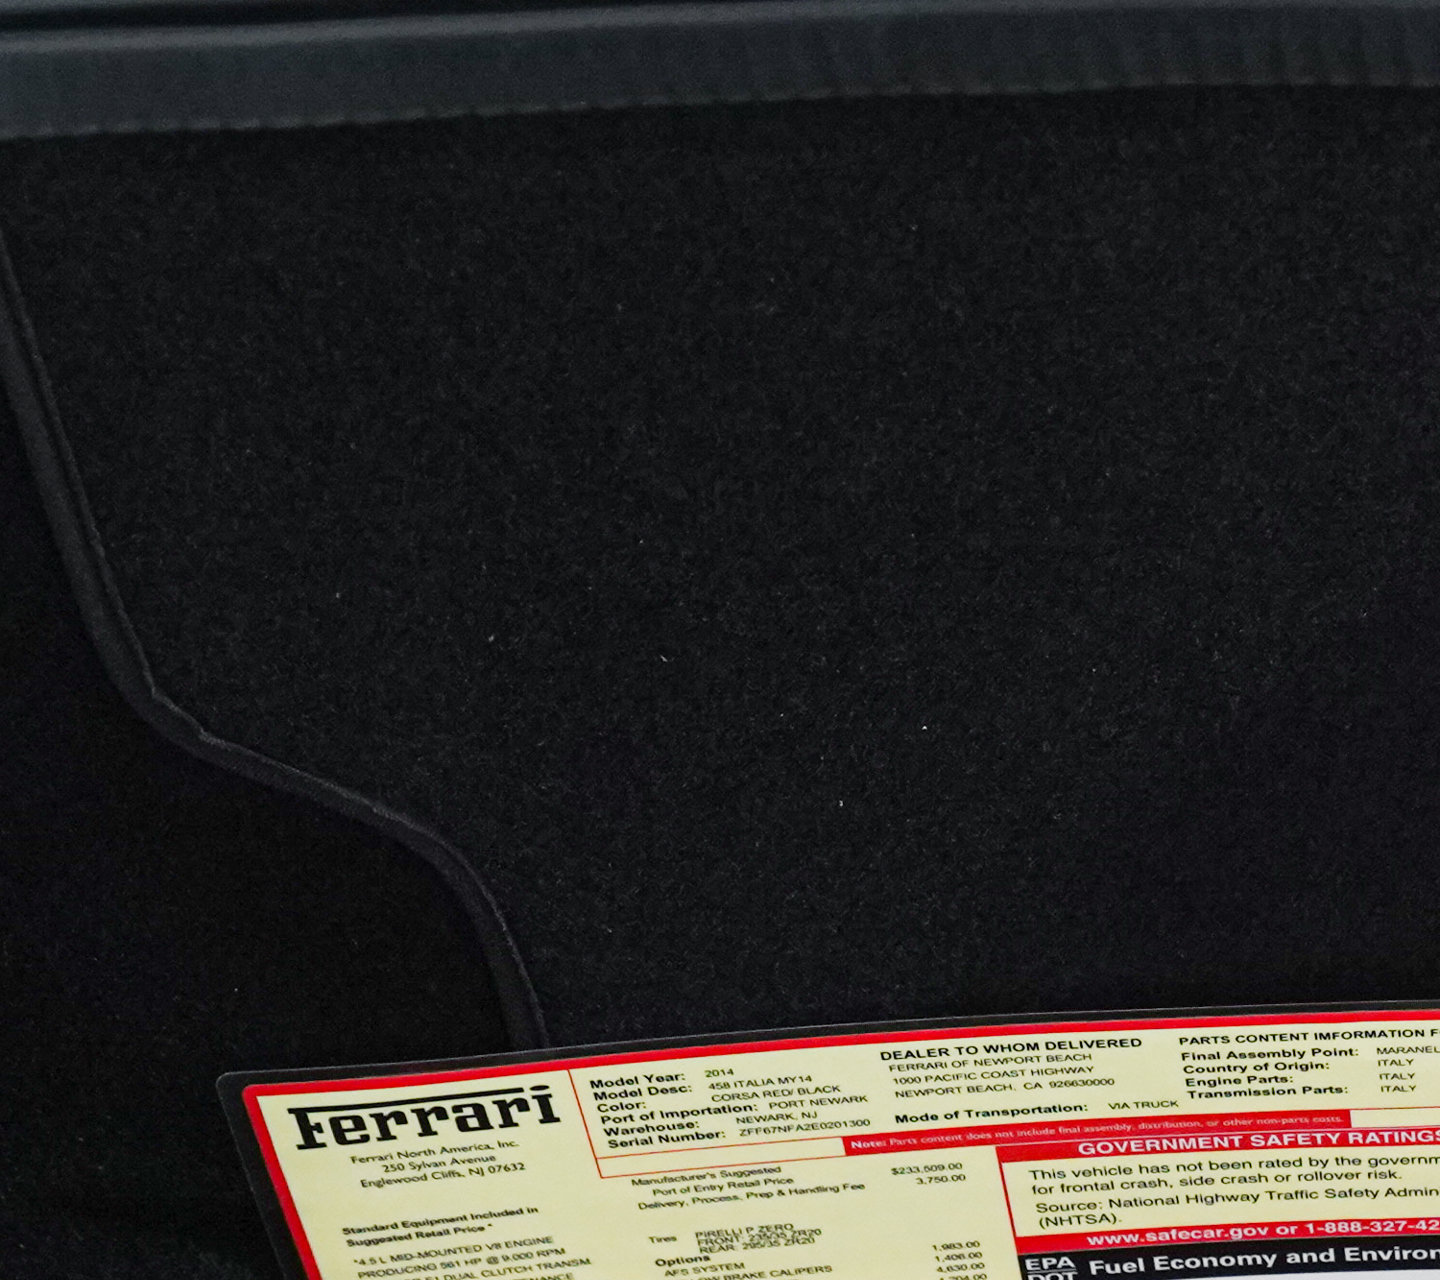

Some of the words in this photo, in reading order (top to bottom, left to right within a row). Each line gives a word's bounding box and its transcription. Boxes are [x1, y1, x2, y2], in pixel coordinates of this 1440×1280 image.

[879, 1048, 951, 1061] DEALER
[953, 1046, 979, 1056] TO
[982, 1042, 1040, 1054] WHOM
[1044, 1038, 1142, 1051] DELIVERED
[1178, 1036, 1231, 1046] PARTS
[1234, 1032, 1309, 1044] CONTENT
[888, 1062, 948, 1072] FERRARI
[950, 1060, 968, 1069] OF
[972, 1055, 1042, 1067] NEWPORT
[1045, 1054, 1092, 1063] BEACH
[1180, 1051, 1221, 1062] Final
[1225, 1049, 1306, 1060] Assembly
[1310, 1048, 1359, 1057] Point:
[892, 1076, 922, 1085] 1000
[923, 1072, 977, 1083] PACIFIC
[980, 1069, 1025, 1080] COAST
[1029, 1066, 1094, 1077] HIGHWAY
[1182, 1064, 1248, 1075] Country
[1252, 1062, 1269, 1072] of
[1273, 1062, 1330, 1072] Origin:
[1376, 1059, 1414, 1067] ITALY
[588, 1076, 640, 1090] Model
[642, 1073, 685, 1084] Year:
[705, 1068, 734, 1078] 2014
[592, 1088, 643, 1102] Model
[646, 1086, 692, 1096] Desc:
[733, 1078, 775, 1088] ITALIA
[894, 1086, 962, 1098] NEWPORT
[1022, 1082, 1043, 1091] CA
[1184, 1077, 1242, 1088] Engine
[1246, 1075, 1293, 1084] Parts:
[1378, 1073, 1415, 1081] ITALY
[596, 1102, 646, 1113] Color:
[796, 1085, 841, 1096] BLACK
[1186, 1087, 1297, 1099] Transmission
[1301, 1086, 1348, 1095] Parts:
[1380, 1085, 1417, 1093] ITALY
[287, 1084, 561, 1150] Ferrari
[600, 1114, 635, 1125] Port
[638, 1111, 655, 1122] of
[659, 1104, 758, 1120] Importation:
[768, 1100, 805, 1110] PORT
[808, 1095, 868, 1106] NEWARK
[894, 1113, 939, 1124] Mode
[943, 1110, 960, 1120] of
[963, 1104, 1088, 1119] Transportation:
[1107, 1102, 1131, 1110] VIA
[1132, 1100, 1179, 1109] TRUCK
[602, 1121, 700, 1137] Warehouse:
[800, 1111, 818, 1119] NJ
[607, 1136, 654, 1149] Serial
[657, 1131, 726, 1144] Number:
[1078, 1136, 1243, 1155] GOVERNMENT
[1249, 1133, 1341, 1147] SAFETY
[349, 1153, 394, 1165] Ferrari
[395, 1148, 437, 1160] North
[496, 1140, 519, 1149] Inc.
[381, 1163, 406, 1173] 250
[407, 1161, 447, 1172] Sylvan
[449, 1155, 497, 1166] Avenue
[1028, 1169, 1067, 1181] This
[1070, 1165, 1133, 1178] vehicle
[1137, 1164, 1171, 1175] has
[1175, 1162, 1203, 1173] not
[1207, 1160, 1253, 1171] been
[1257, 1157, 1303, 1169] rated
[1307, 1157, 1329, 1169] by
[1334, 1156, 1362, 1166] the
[359, 1173, 428, 1189] Englewood
[467, 1167, 485, 1177] NJ
[486, 1162, 526, 1174] 07632
[1031, 1185, 1054, 1195] for
[1059, 1180, 1115, 1193] frontal
[1119, 1178, 1174, 1190] crash,
[1178, 1176, 1215, 1187] side
[1220, 1173, 1269, 1185] crash
[1273, 1174, 1292, 1183] or
[1296, 1171, 1362, 1182] rollover
[1366, 1169, 1402, 1180] risk.
[1035, 1202, 1103, 1214] Source:
[1107, 1195, 1180, 1209] National
[1184, 1193, 1260, 1206] Highway
[1265, 1190, 1319, 1201] Traffic
[1323, 1188, 1380, 1200] Safety
[1038, 1213, 1123, 1229] (NHTSA).
[1086, 1222, 1268, 1246] www.safecar.gov
[1275, 1223, 1298, 1236] or
[1024, 1256, 1076, 1271] EPA
[1088, 1257, 1145, 1276] Fuel
[1152, 1254, 1277, 1271] Economy
[1285, 1248, 1336, 1264] and
